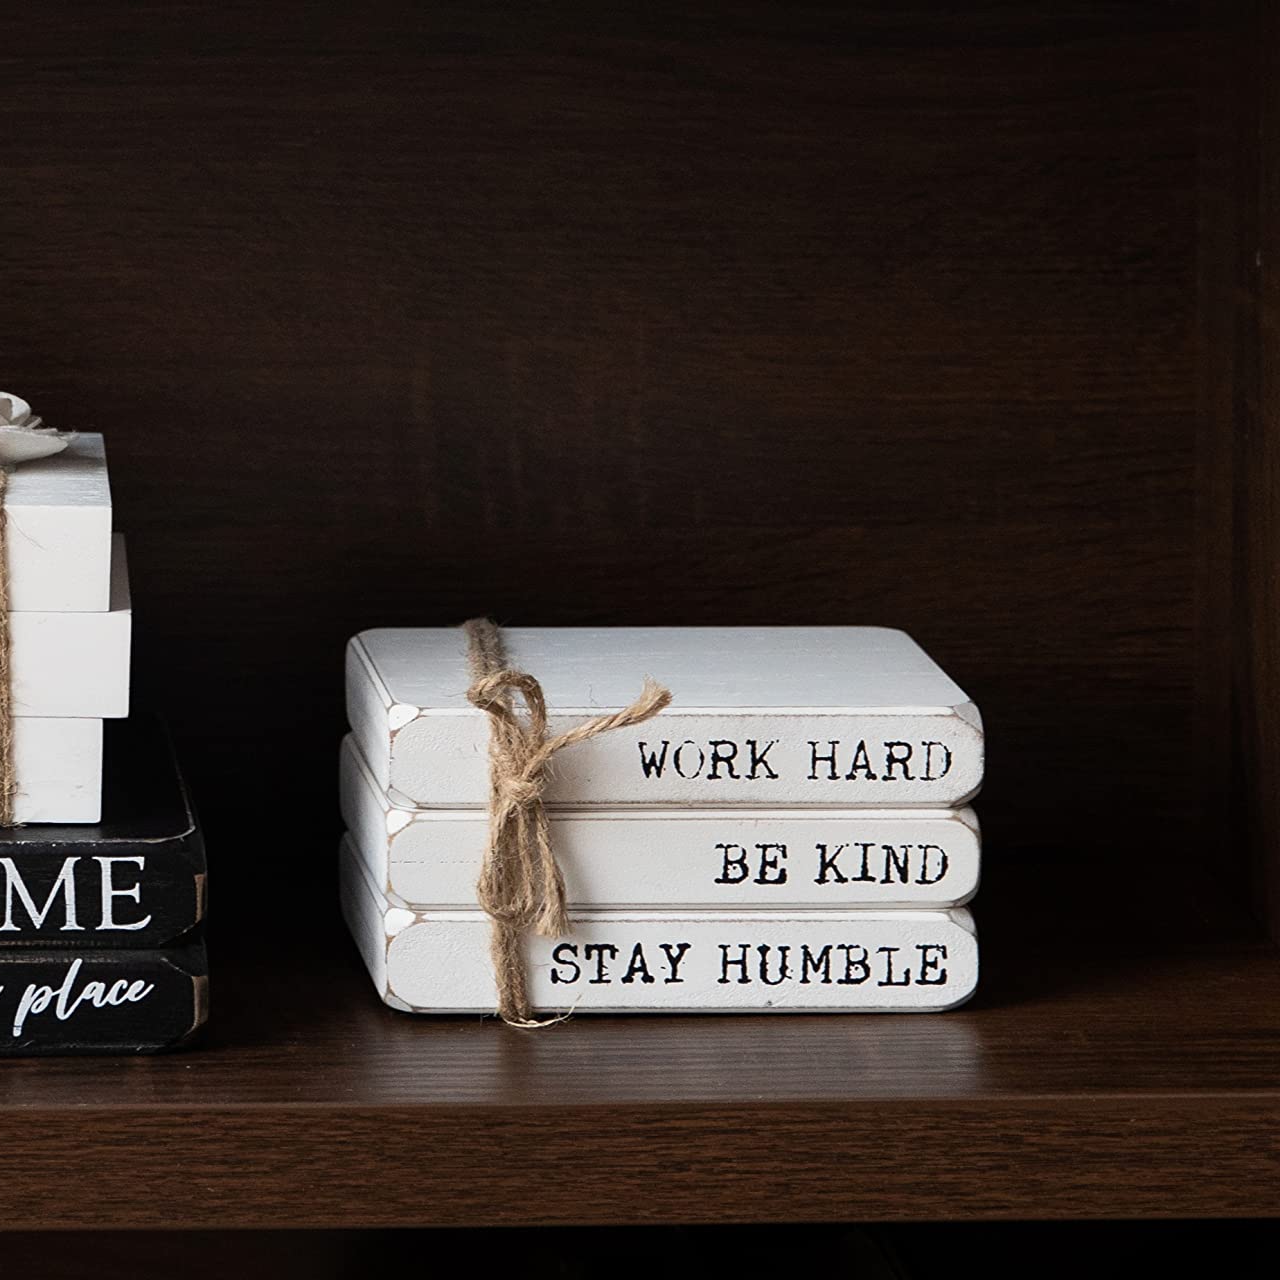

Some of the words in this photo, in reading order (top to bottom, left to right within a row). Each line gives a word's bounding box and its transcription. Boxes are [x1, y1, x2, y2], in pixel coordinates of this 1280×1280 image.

[638, 739, 779, 780] WORK
[807, 740, 952, 781] HARD
[714, 843, 787, 885] BE
[814, 843, 948, 885] KIND
[551, 943, 691, 984] STAY
[717, 944, 947, 987] HUMBLE
[13, 959, 154, 1036] place
